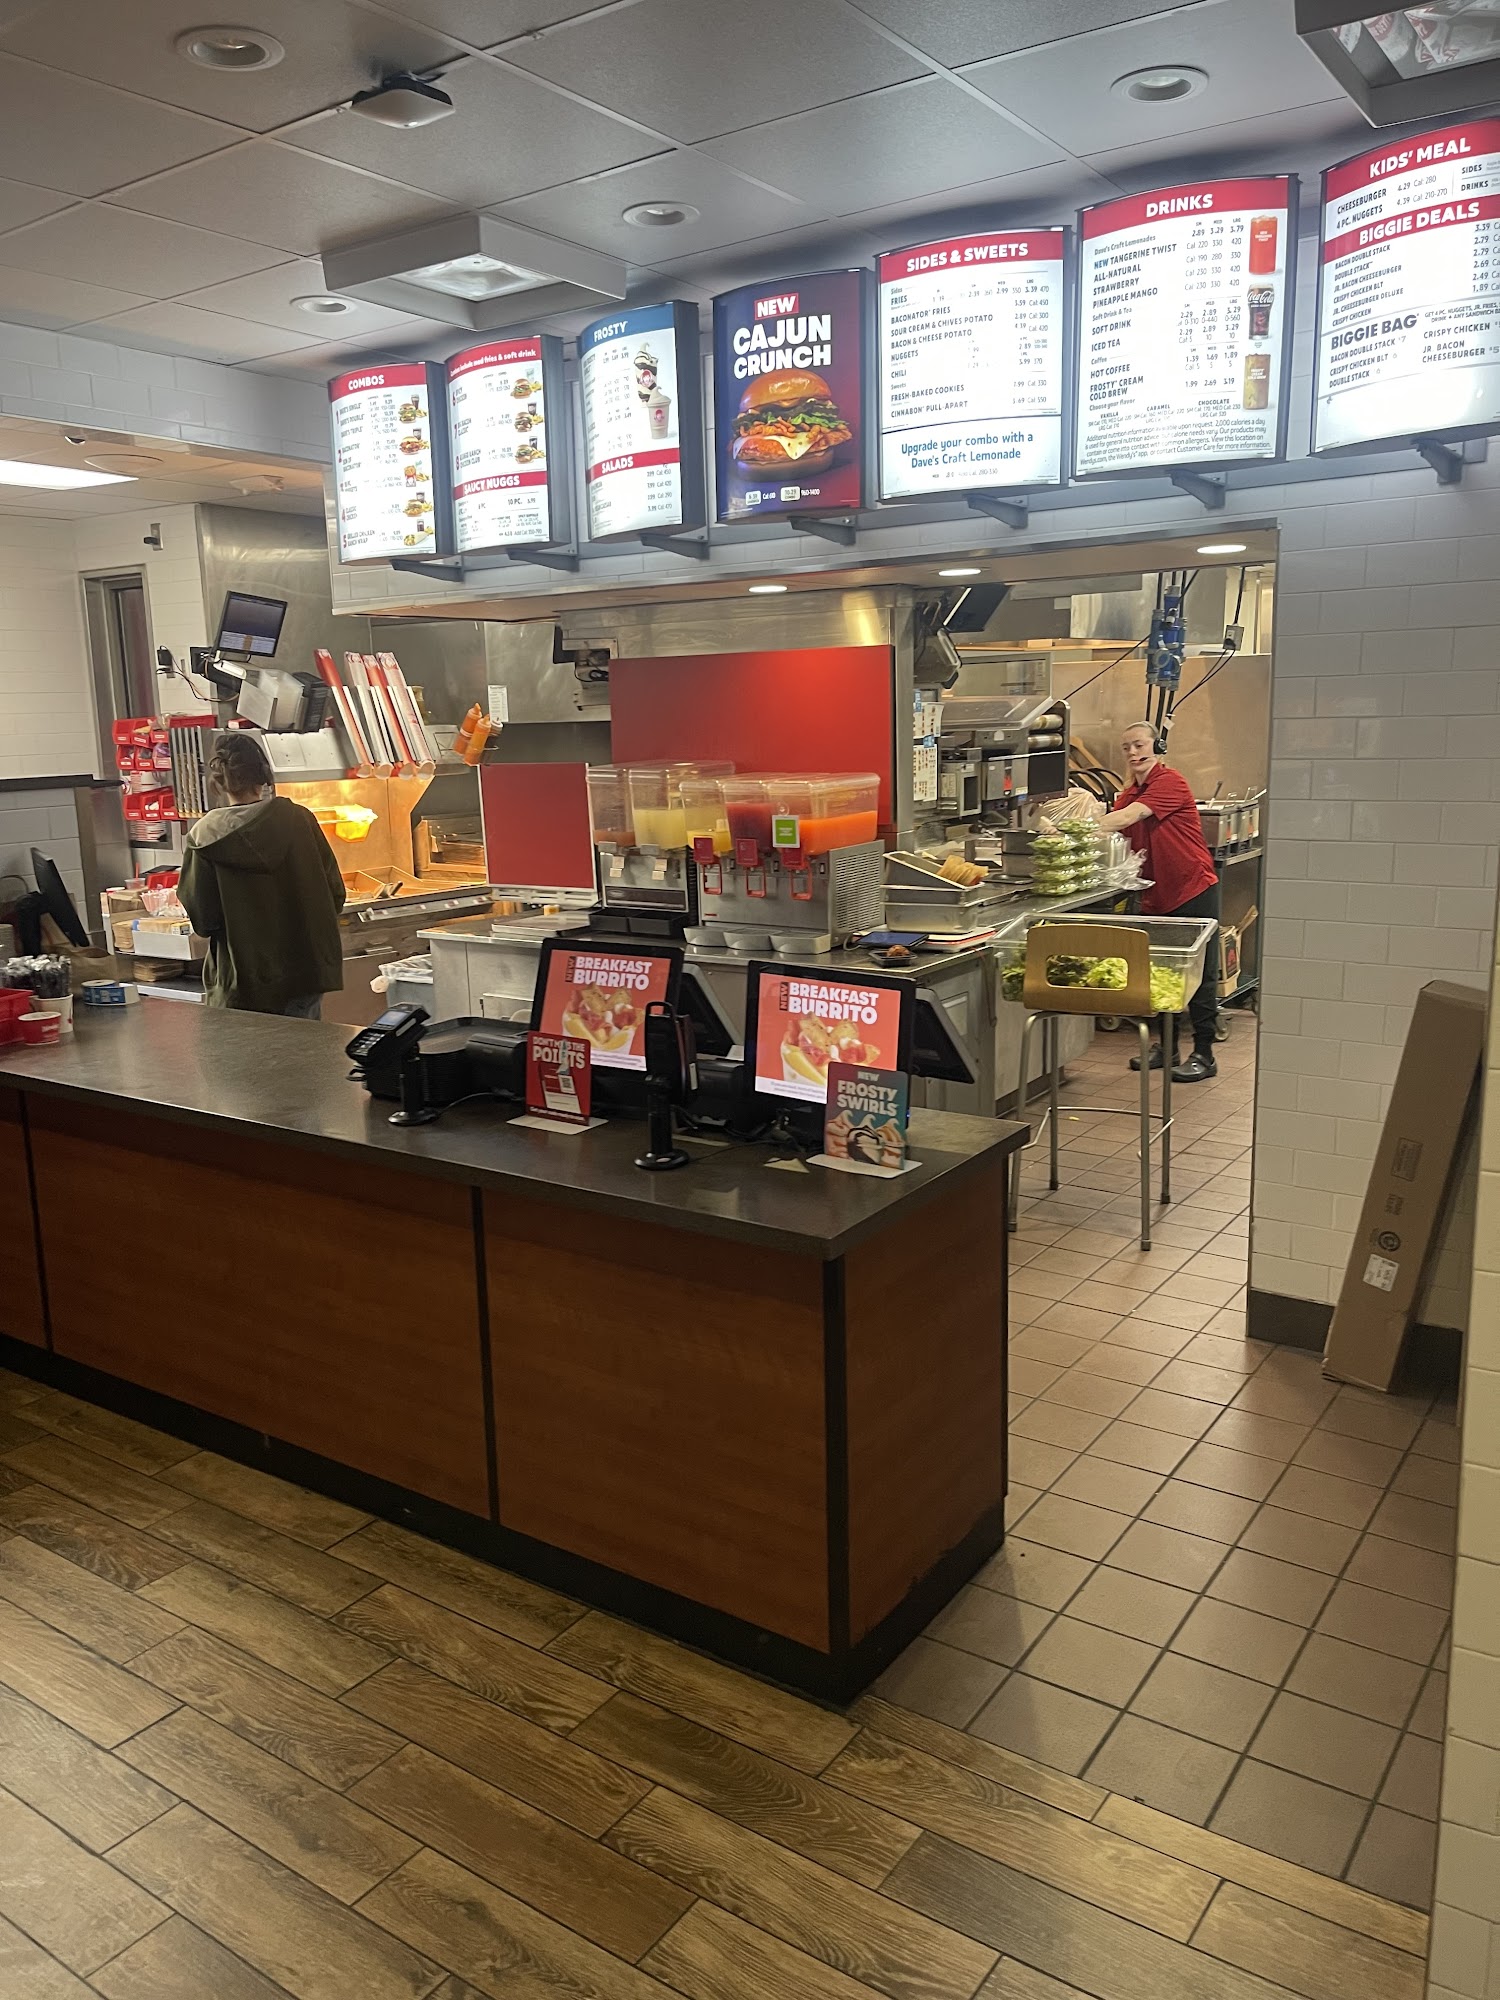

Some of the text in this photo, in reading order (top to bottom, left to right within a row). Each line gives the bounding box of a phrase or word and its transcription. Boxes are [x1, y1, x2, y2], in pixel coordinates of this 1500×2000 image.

[1369, 138, 1471, 178] KIDS' MEAL
[1462, 164, 1482, 174] SIDES
[1461, 181, 1488, 191] DRINKS
[1146, 194, 1213, 218] DRINKS
[1338, 188, 1386, 214] CHEESEBURGER
[1337, 221, 1340, 229] 4
[1352, 205, 1383, 223] NUGGETS
[1360, 202, 1479, 245] BIGGIE DEALS
[1230, 225, 1244, 233] 3.79
[1111, 242, 1124, 250] Craft
[1125, 235, 1156, 247] Lemonades
[1335, 223, 1490, 270] BACON DOUBLE STACK 3.39
[907, 243, 1028, 272] SIDES & SWEETS
[1094, 244, 1177, 269] NEW TANGERINE TWIST
[1335, 269, 1352, 281] DOUBLE
[1474, 236, 1489, 244] 2.79
[1094, 264, 1141, 282] ALL-NATURAL
[1342, 278, 1358, 289] BACON
[1359, 265, 1402, 283] CHEESEBURGER
[1473, 248, 1489, 256] 2.79
[1093, 278, 1139, 295] STRAWBERRY
[1334, 293, 1349, 303] CRISPY
[1351, 285, 1372, 297] CHICKEN
[1474, 260, 1489, 268] 2.69
[891, 295, 907, 305] FRIES
[1093, 288, 1158, 309] PINEAPPLE MANGO
[1341, 295, 1379, 312] CHEESEBURGER
[1381, 288, 1403, 299] DELUXE
[1473, 272, 1488, 280] 2.49
[757, 296, 795, 318] NEW
[933, 306, 950, 315] FRIES
[1332, 316, 1348, 326] CRISPY
[1350, 308, 1371, 320] CHICKEN
[594, 321, 626, 342] FROSTY
[733, 315, 831, 355] CAJUN
[891, 327, 907, 337] SOUR
[909, 323, 930, 333] CREAM
[938, 318, 962, 327] CHIVES
[965, 314, 993, 323] POTATO
[1092, 319, 1131, 335] SOFT DRINK
[1424, 323, 1490, 338] CRISPY CHICKEN
[891, 339, 911, 349] BACON
[919, 333, 942, 343] CHEESE
[944, 329, 972, 338] POTATO
[1092, 339, 1120, 352] ICED TEA
[1331, 323, 1378, 350] BIGGIE
[1437, 340, 1464, 351] BACON
[484, 355, 497, 363] fries
[518, 349, 536, 357] drink
[891, 350, 918, 361] NUGGETS
[1331, 338, 1395, 363] BACON DOUBLE STACK
[1423, 348, 1485, 363] CHEESEBURGER
[733, 345, 831, 379] CRUNCH
[1091, 364, 1130, 378] HOT COFFEE
[1330, 354, 1388, 376] CRISPY CHICKEN BLT
[348, 375, 384, 390] COMBOS
[891, 370, 907, 378] CHILI
[1119, 376, 1143, 386] CREAM
[1329, 370, 1370, 388] DOUBLE STACK
[891, 385, 965, 401] FRESH-BAKED COOKIES
[1090, 387, 1128, 401] COLD BREW
[926, 401, 968, 412] PULL-APART
[1108, 401, 1118, 409] your
[902, 440, 937, 456] Upgrade
[941, 439, 962, 451] your
[966, 433, 998, 445] combo
[1003, 431, 1024, 443] with
[602, 456, 633, 473] SALADS
[912, 448, 1020, 468] Dave's Craft Lemonade
[464, 475, 520, 495] SAUCY NUGGS
[567, 957, 576, 982] NEW
[575, 957, 652, 974] BREAKFAST
[573, 970, 650, 990] BURRITO
[780, 982, 789, 1011] NEW
[789, 982, 879, 1006] BREAKFAST
[789, 997, 877, 1024] BURRITO
[533, 1037, 554, 1046] DON'T
[573, 1043, 585, 1052] THE
[858, 1071, 879, 1082] NEW
[837, 1080, 897, 1099] FROSTY
[837, 1096, 897, 1116] SWIRLS
